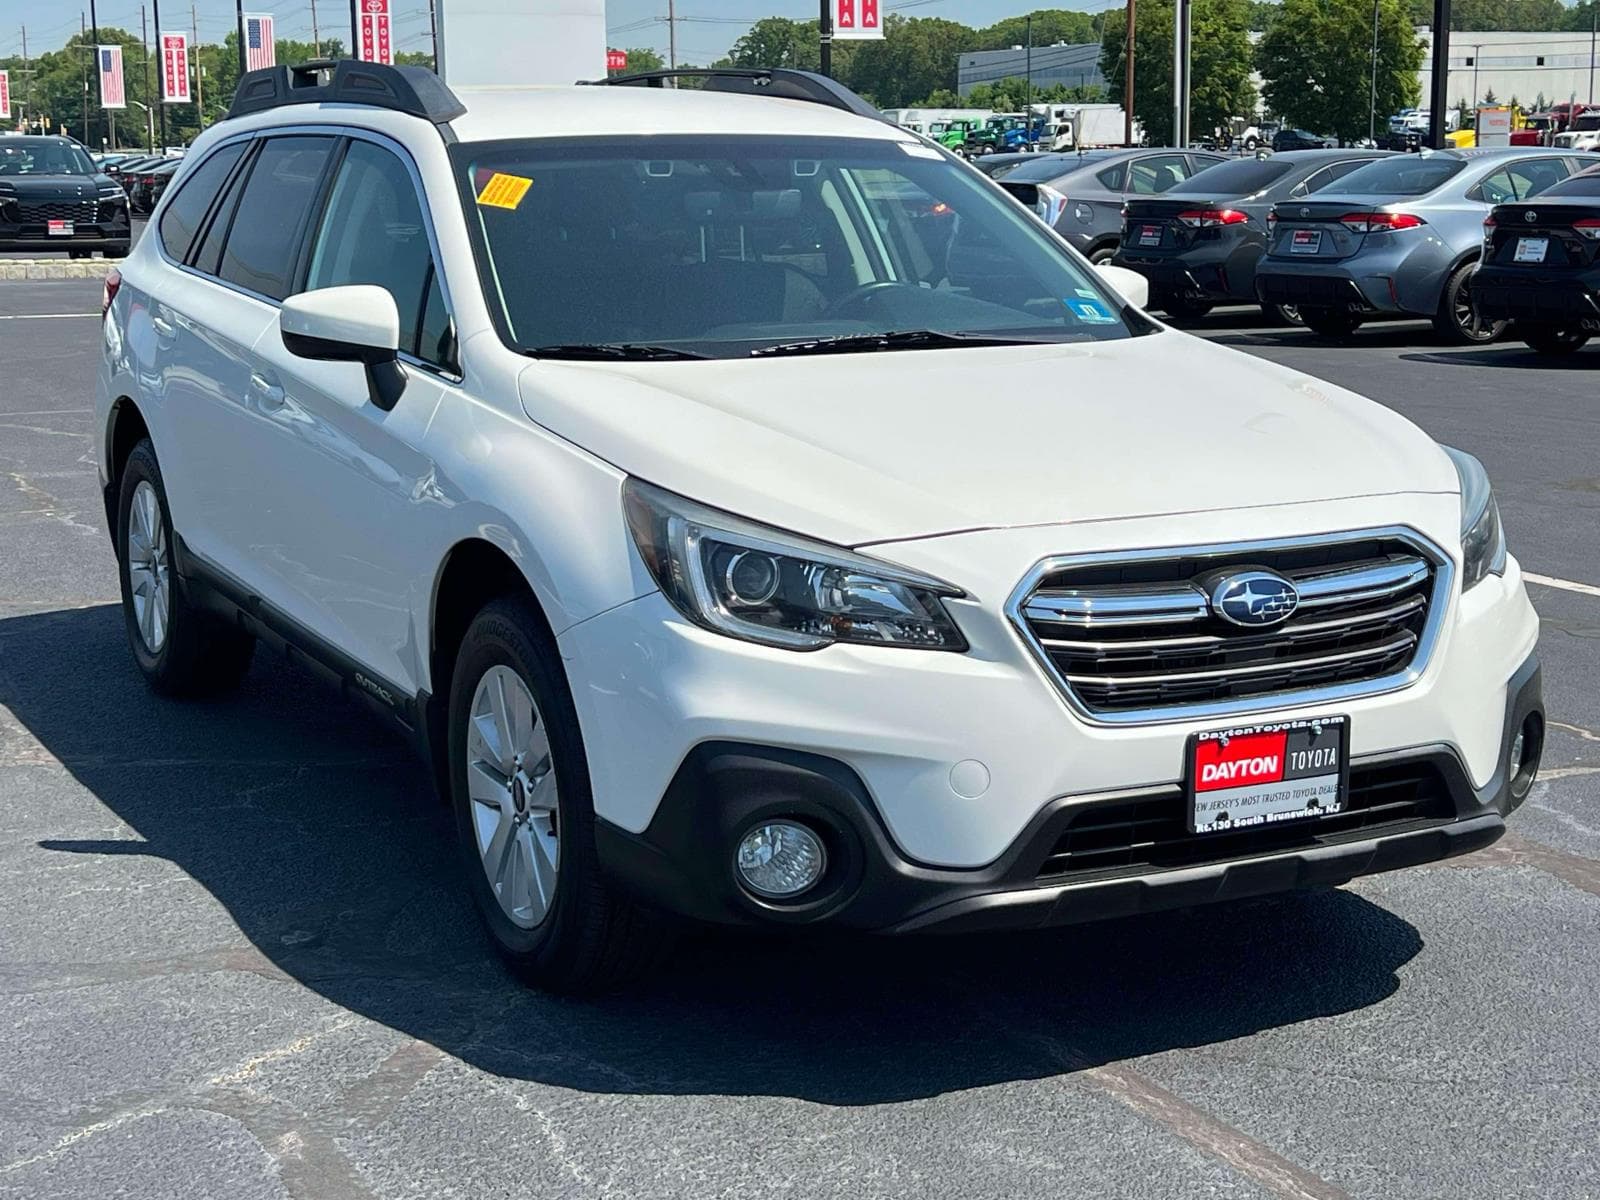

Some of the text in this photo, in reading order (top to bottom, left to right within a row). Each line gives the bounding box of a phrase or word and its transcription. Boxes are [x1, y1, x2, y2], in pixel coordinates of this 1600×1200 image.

[364, 17, 373, 62] TOYO
[380, 17, 388, 64] TOYOT
[1198, 716, 1345, 741] DaytonToyota.com
[1201, 747, 1336, 783] DAYTON TOYOTA
[1195, 783, 1339, 812] EW JERSEY'S MOST TRUSTED TOYOTA DEALE
[1233, 814, 1264, 828] South
[1325, 802, 1341, 814] NJ
